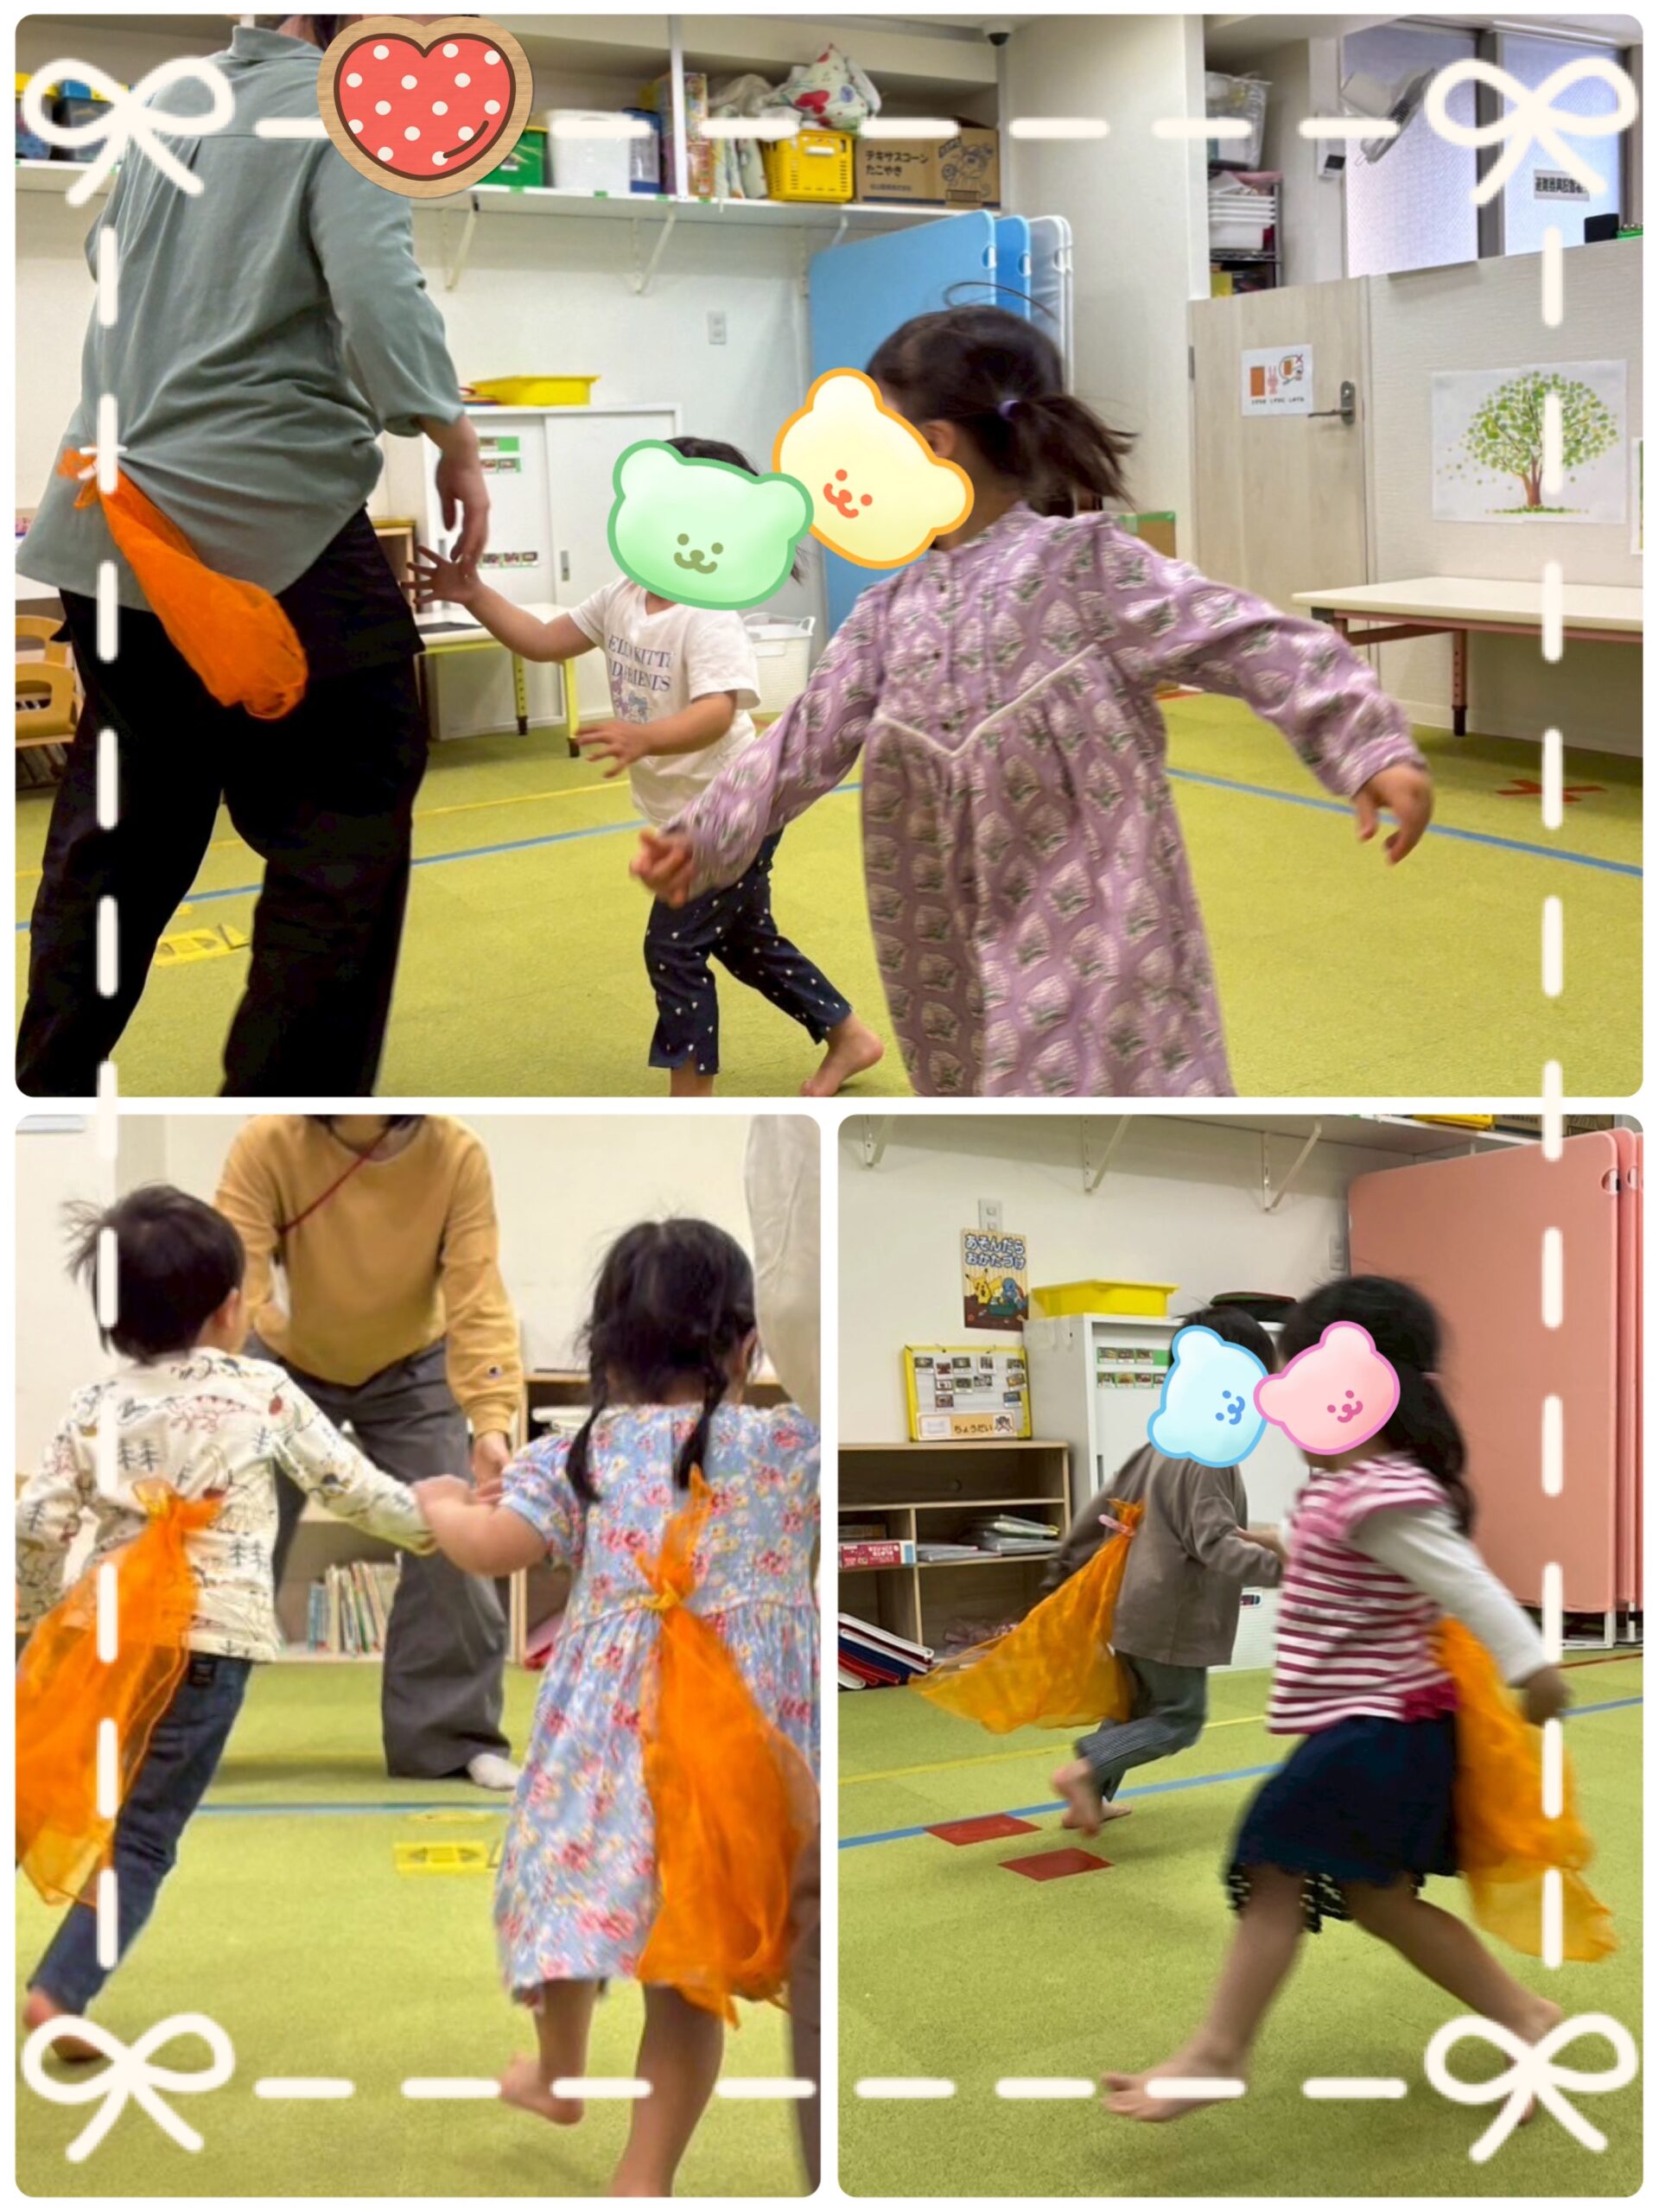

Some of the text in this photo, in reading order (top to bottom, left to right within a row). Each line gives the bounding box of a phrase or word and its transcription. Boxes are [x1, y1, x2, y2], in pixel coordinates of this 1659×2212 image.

[865, 149, 929, 164] テキサスコーン
[866, 164, 902, 177] たこやき
[964, 1233, 1026, 1255] あそんだら
[964, 1251, 1027, 1270] おかたづけ
